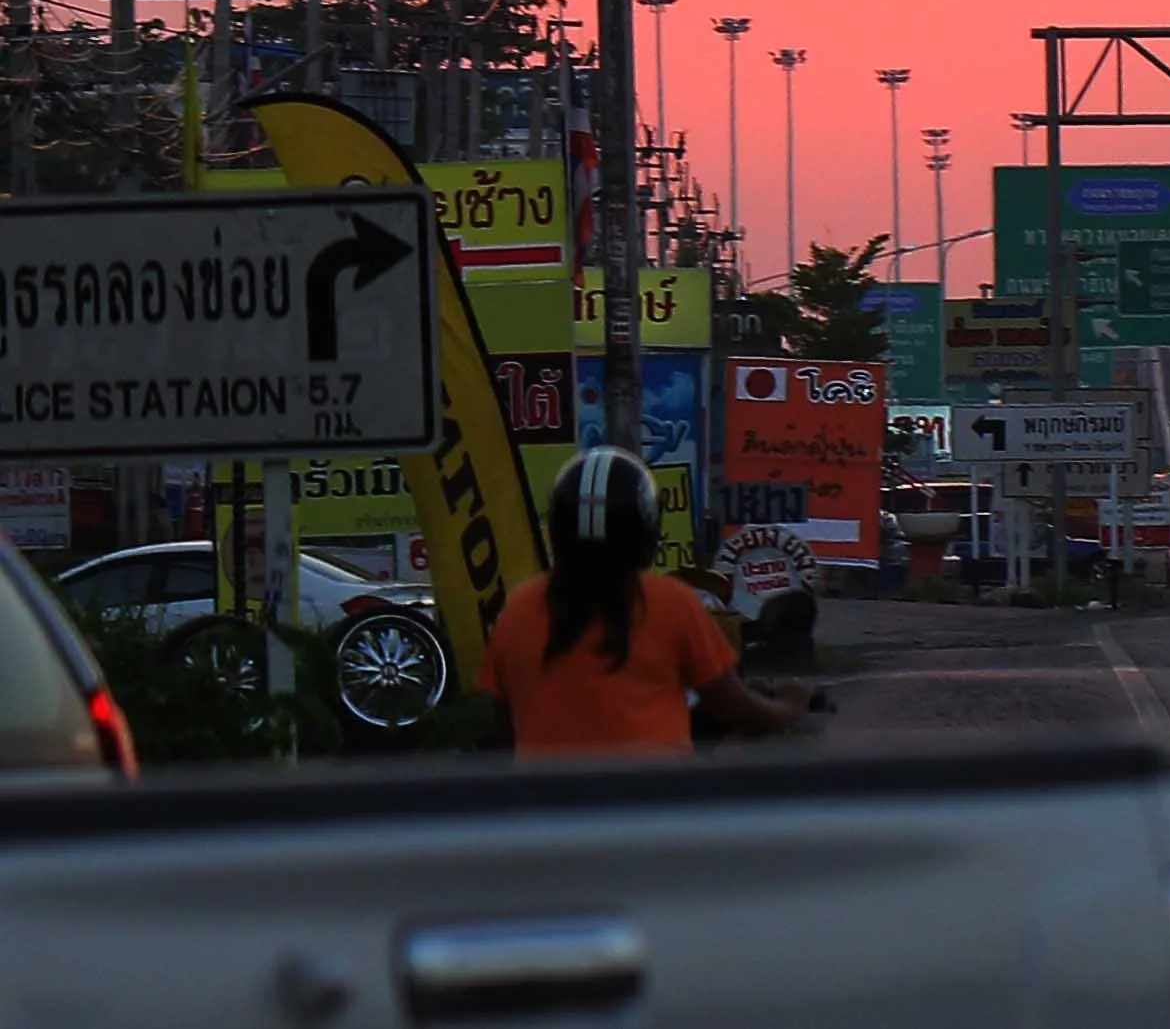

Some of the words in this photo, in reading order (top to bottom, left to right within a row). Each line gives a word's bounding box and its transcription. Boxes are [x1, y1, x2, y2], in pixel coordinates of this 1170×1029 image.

[0, 225, 291, 358] ธรคลองข่อย
[88, 375, 287, 421] STATAION
[308, 373, 363, 405] 5.7
